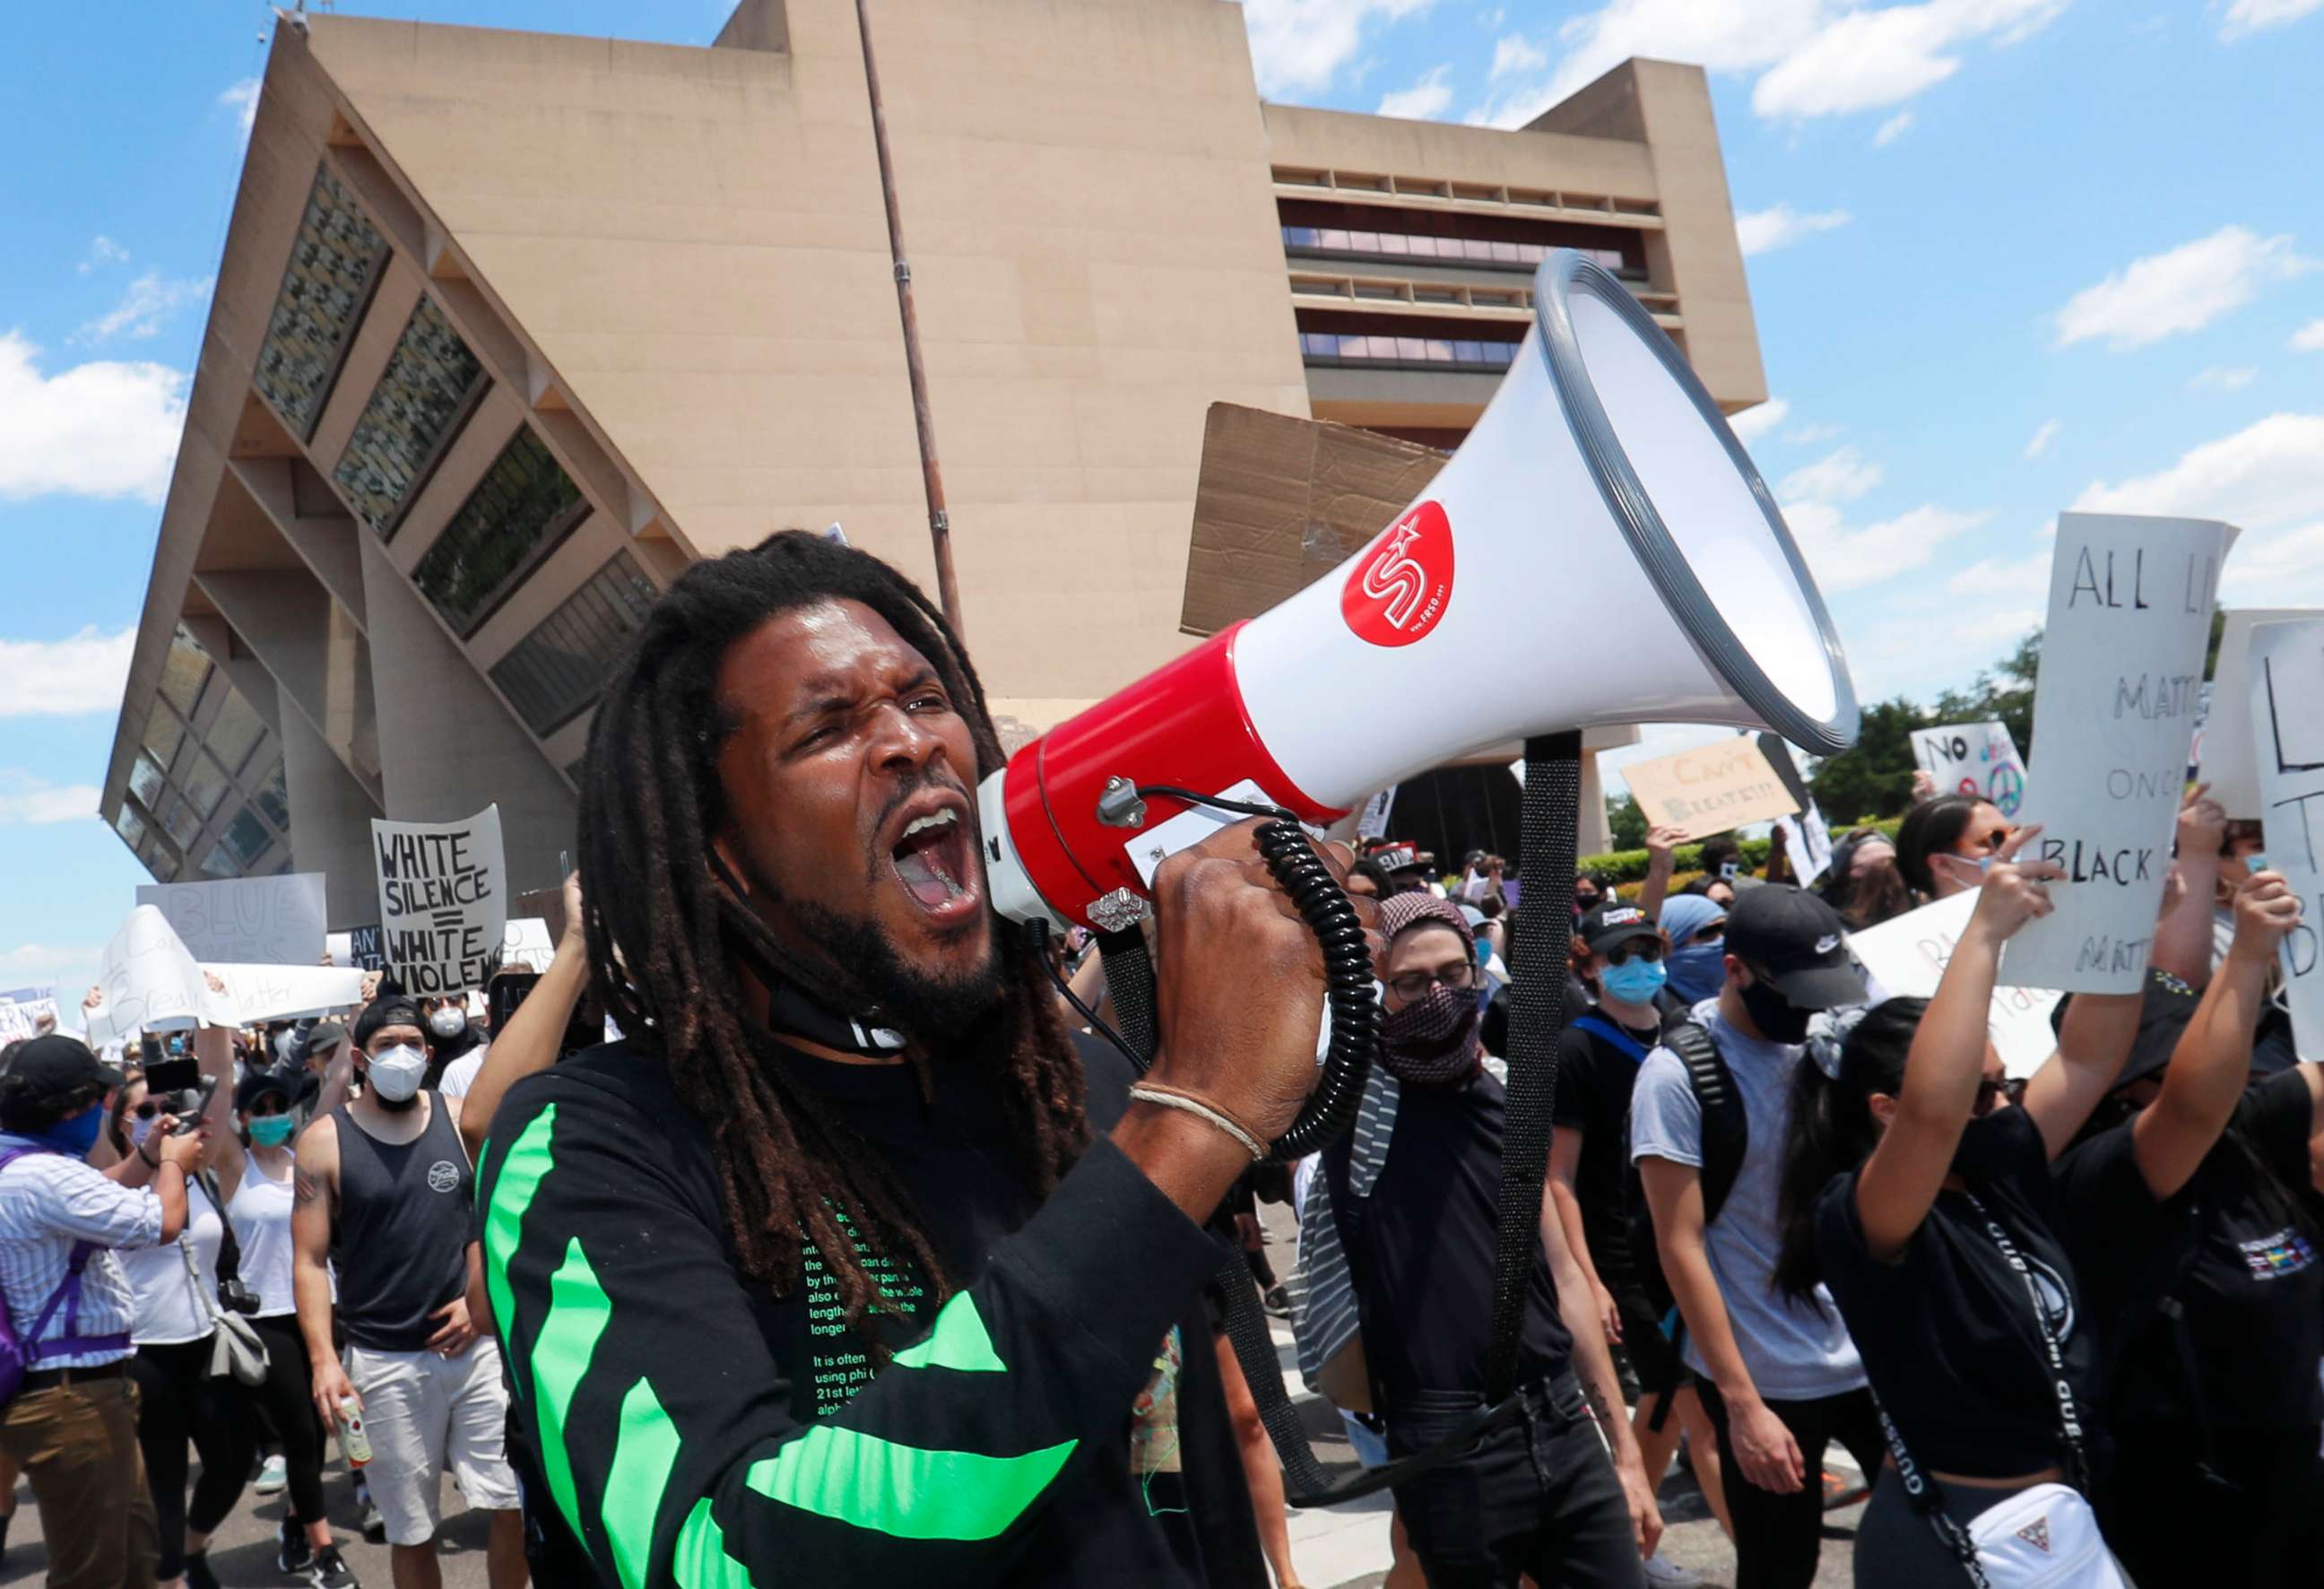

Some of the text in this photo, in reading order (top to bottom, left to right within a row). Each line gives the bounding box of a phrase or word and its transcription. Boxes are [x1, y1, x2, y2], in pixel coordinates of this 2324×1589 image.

[2068, 544, 2149, 610] ALL
[2112, 673, 2197, 720] MATT
[1924, 735, 1968, 771] NO
[377, 829, 476, 880] WHITE
[2037, 838, 2154, 887] BLACK
[168, 882, 311, 939] BLUE
[384, 867, 492, 917] SILENCE
[387, 925, 487, 965] WHITE
[2075, 936, 2154, 974] MATT
[806, 1275, 820, 1289] by
[808, 1291, 831, 1304] also
[813, 1352, 866, 1368] It is often
[814, 1370, 846, 1385] using
[848, 1367, 867, 1383] phi
[816, 1386, 843, 1400] 21st
